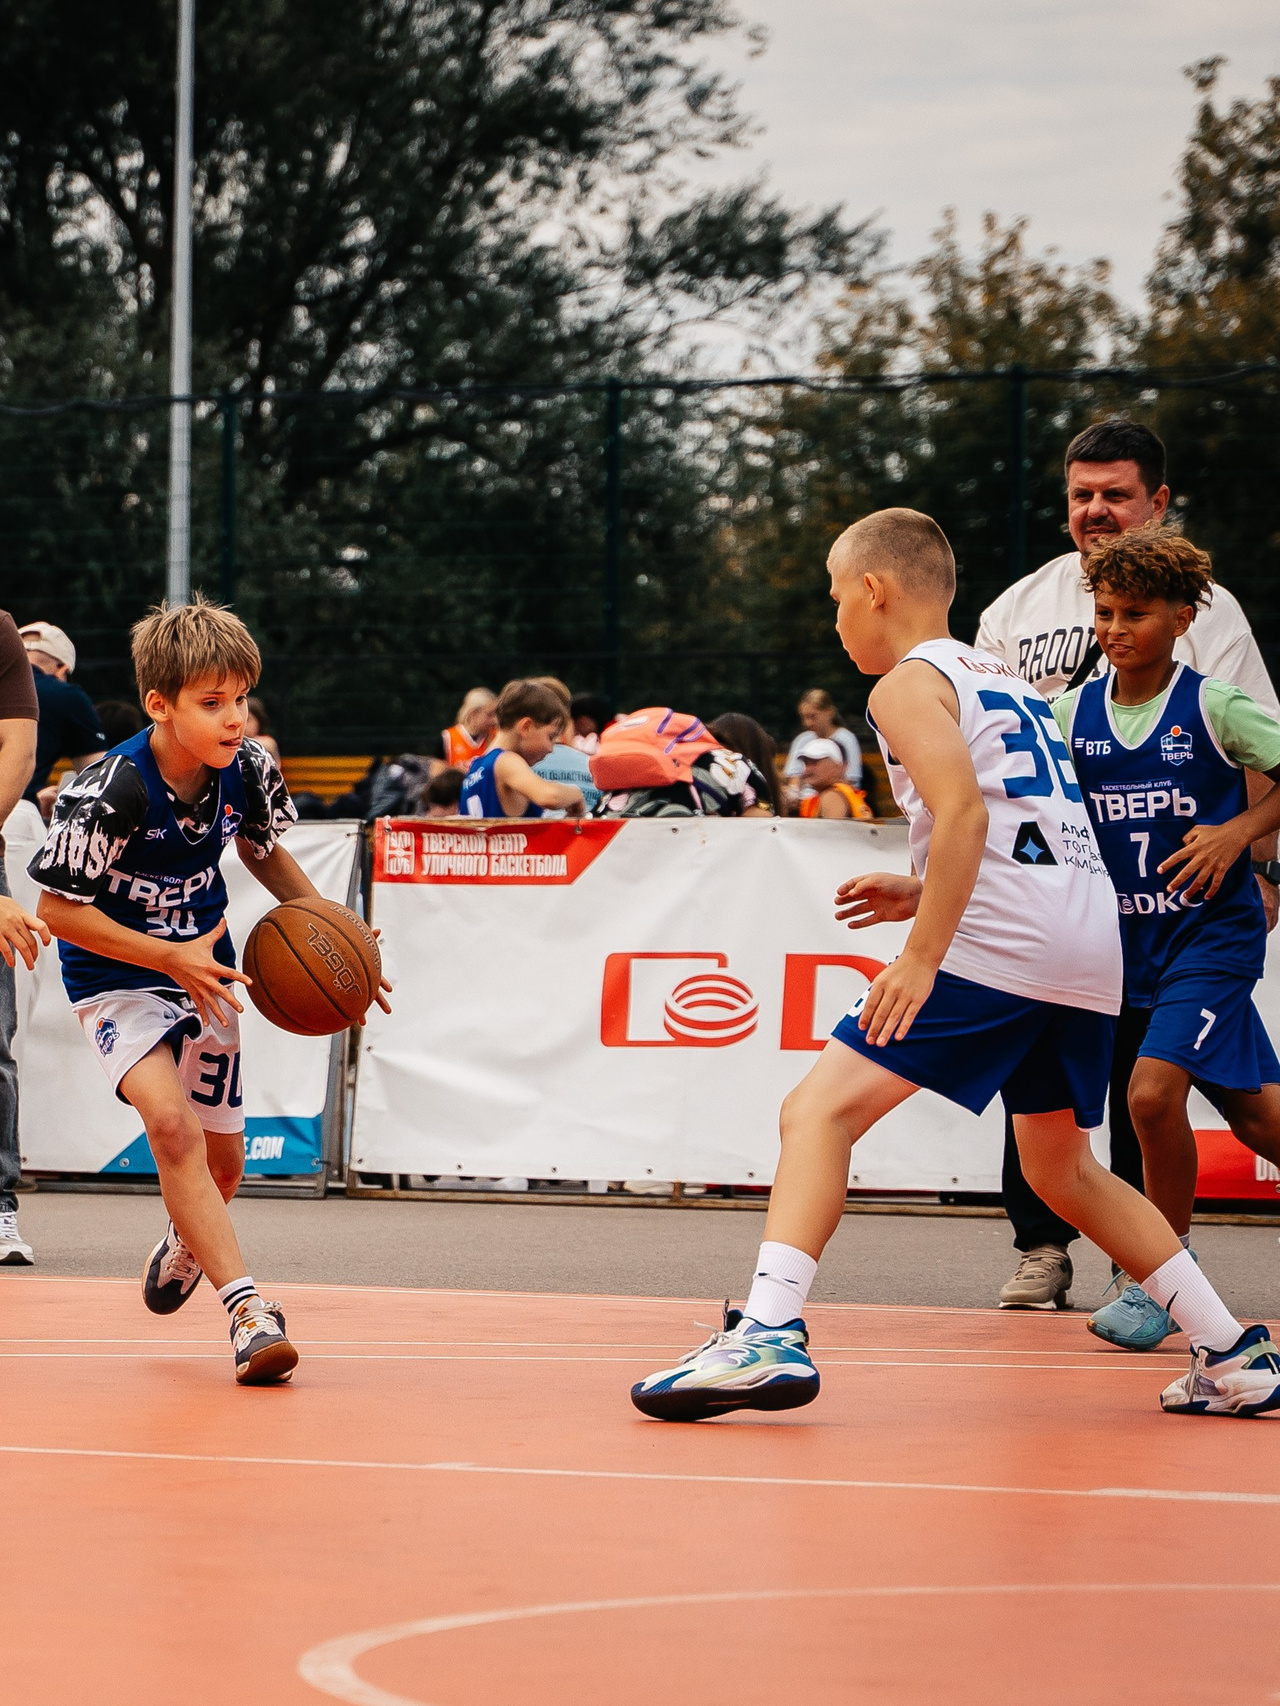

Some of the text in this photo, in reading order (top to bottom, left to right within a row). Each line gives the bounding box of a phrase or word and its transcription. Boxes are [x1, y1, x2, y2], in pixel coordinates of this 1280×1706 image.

[1086, 740, 1111, 756] ВТБ
[1160, 751, 1194, 762] ТВЕРЬ
[1101, 779, 1172, 791] БАСКЕТБОЛЬНЫЙ КЛУБ
[1090, 788, 1197, 823] ТВЕРЬ
[422, 832, 487, 854] ТВЕРСКОЙ
[488, 833, 528, 855] ЦЕНТР
[1130, 832, 1150, 878] 7
[421, 855, 567, 876] УЛИЧНОГО БАСКЕТБОЛА
[307, 922, 363, 997] JÖGEL
[1194, 1008, 1217, 1051] 7
